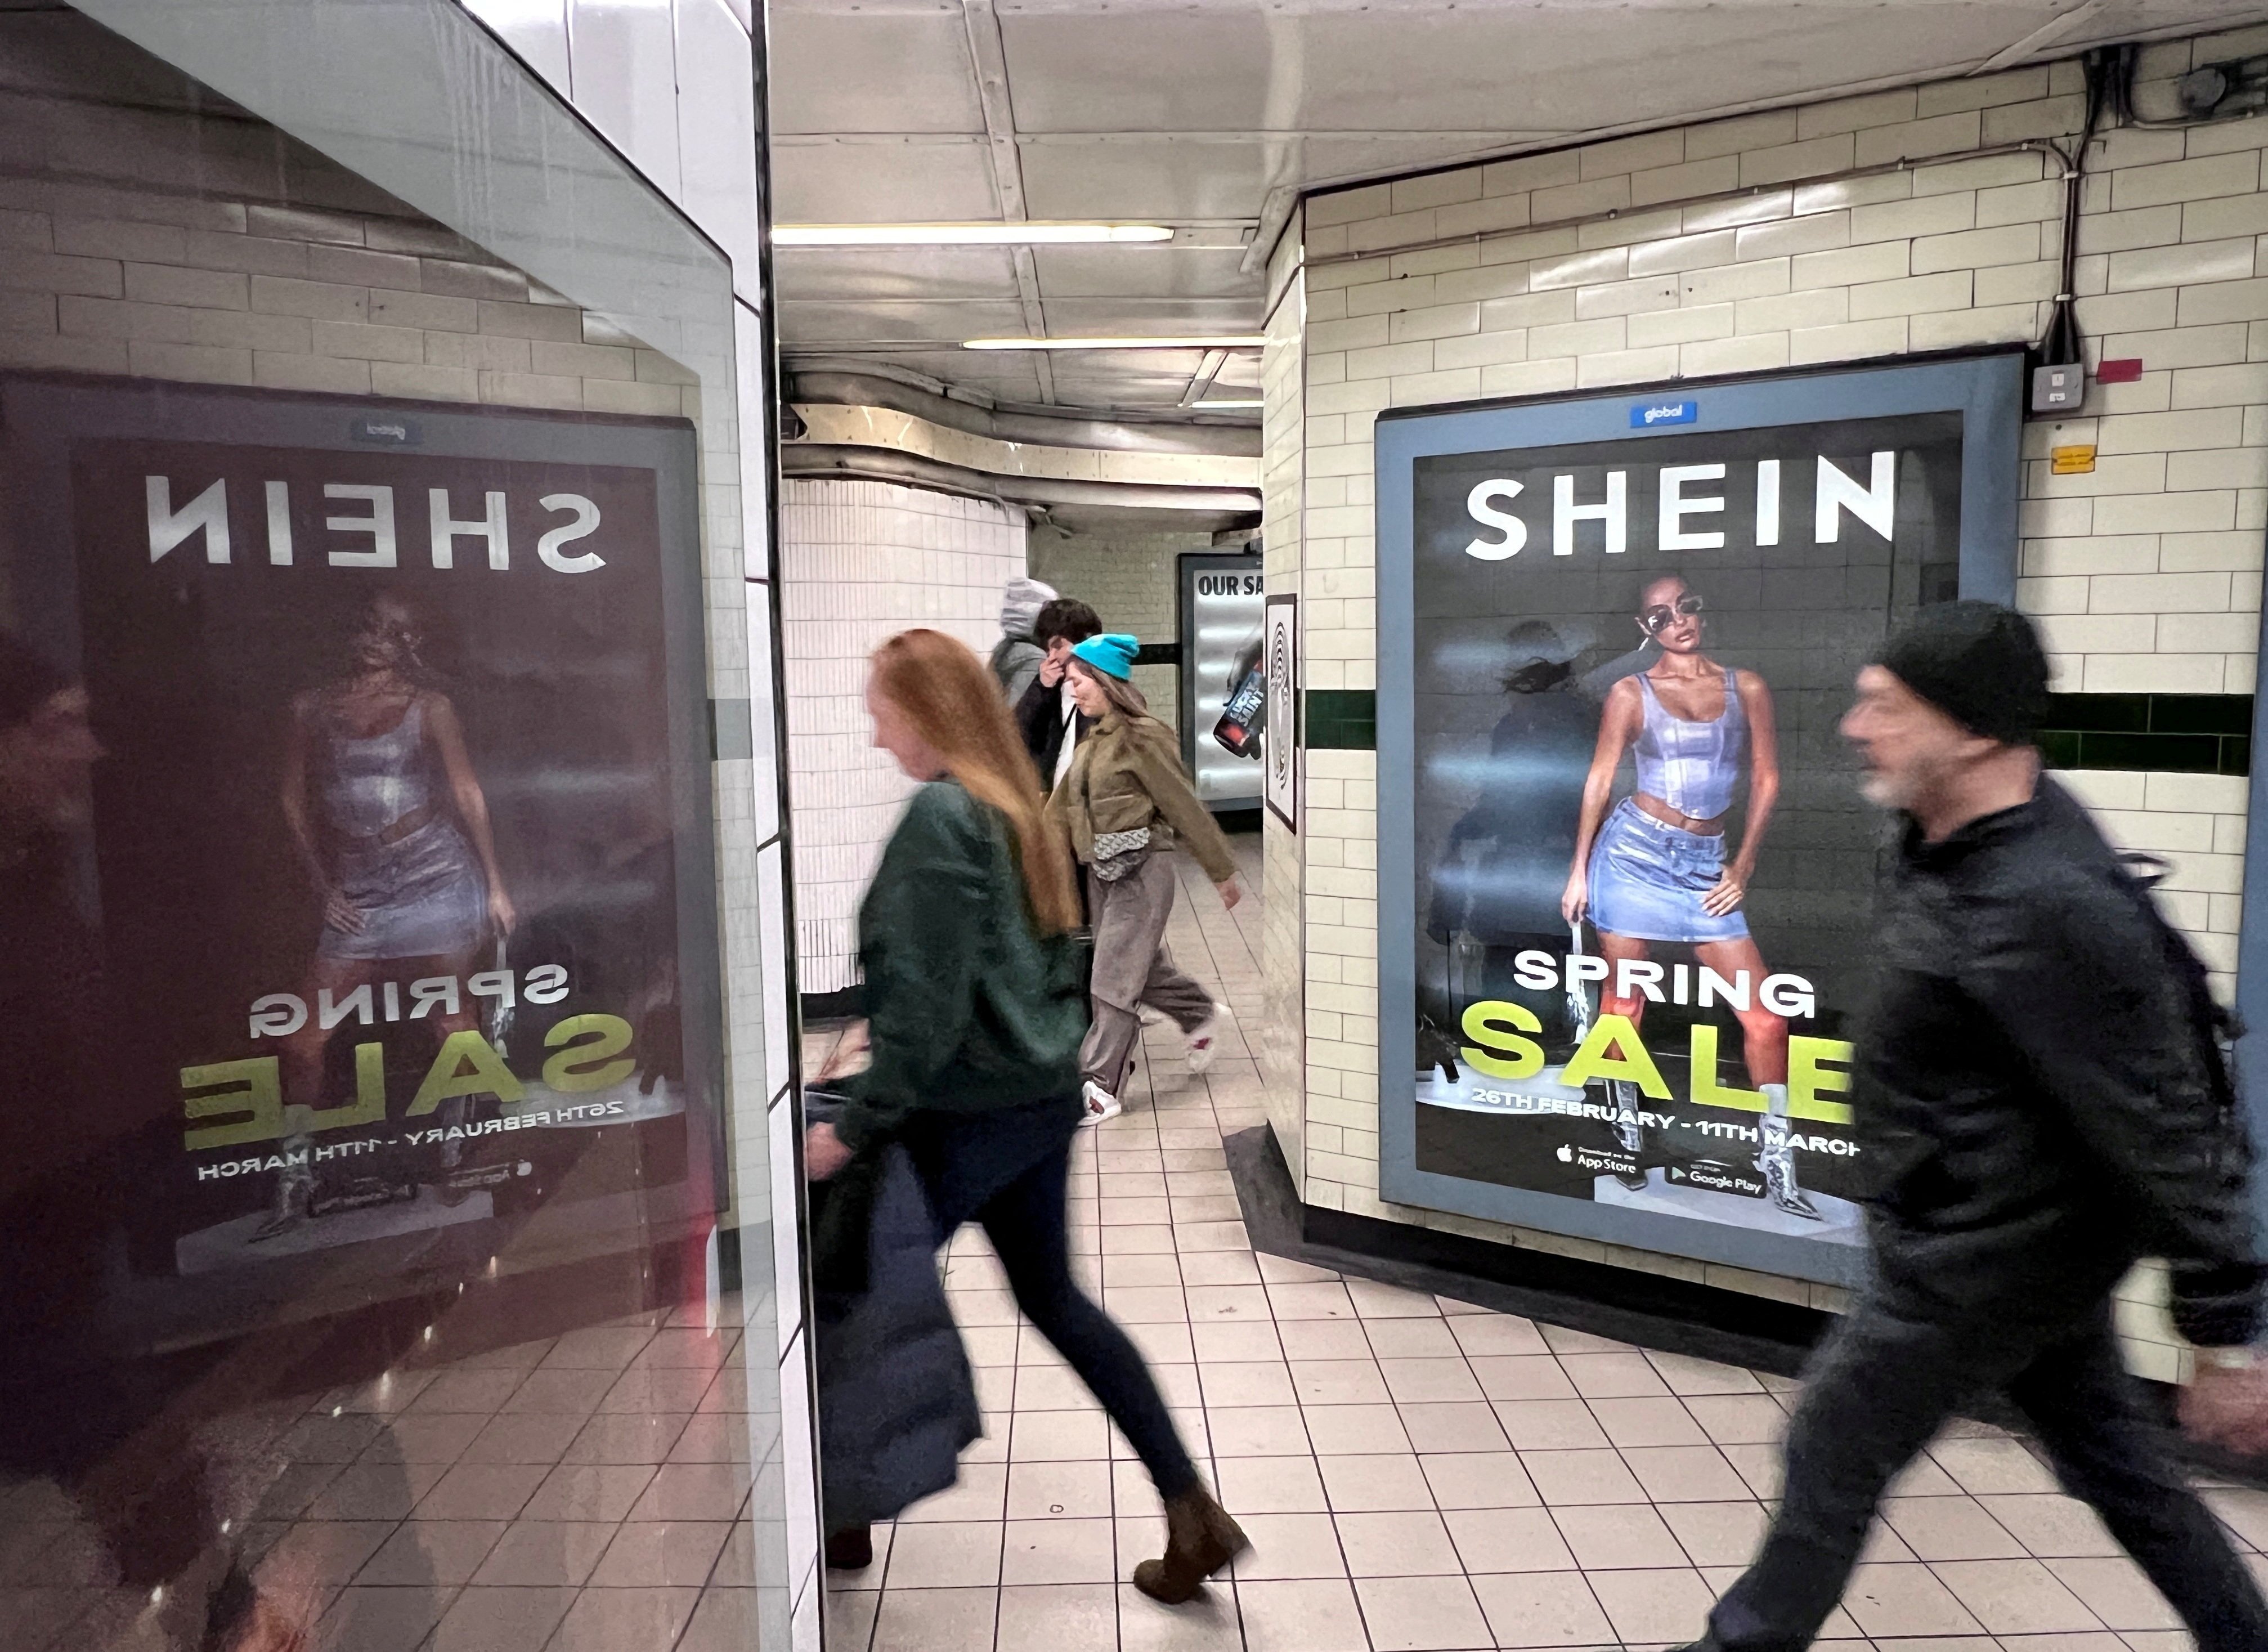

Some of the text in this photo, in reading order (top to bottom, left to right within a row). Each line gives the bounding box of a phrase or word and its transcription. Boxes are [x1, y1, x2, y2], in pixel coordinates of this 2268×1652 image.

[1644, 404, 1683, 424] global
[1465, 450, 1894, 561] SHEIN
[1198, 576, 1239, 596] OUR
[1513, 950, 1816, 1019] SPRING
[1459, 1000, 1856, 1125] SALE
[1472, 1087, 1532, 1110] 26TH
[1538, 1097, 1675, 1130] FEBRUARY
[1695, 1120, 1758, 1143] 11TH
[1577, 1154, 1637, 1174] App Store
[1690, 1171, 1763, 1195] Google Play
